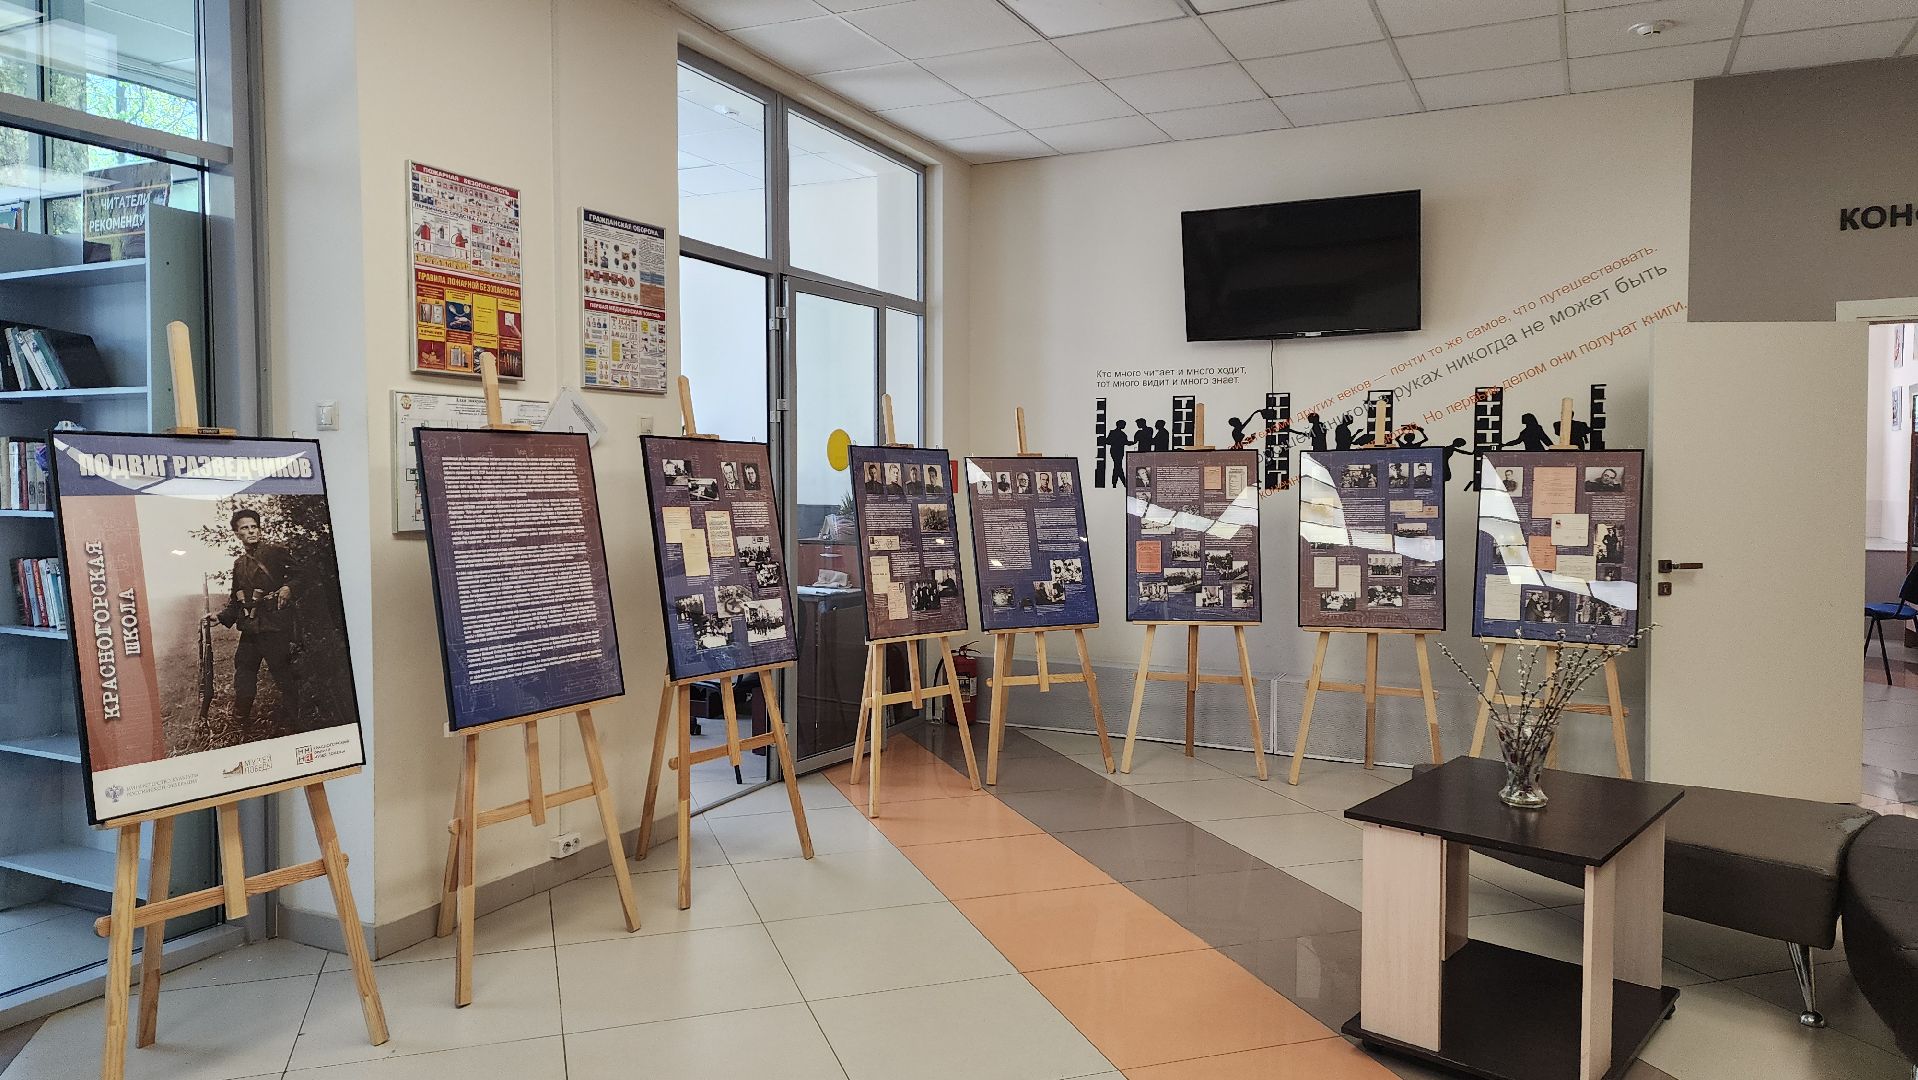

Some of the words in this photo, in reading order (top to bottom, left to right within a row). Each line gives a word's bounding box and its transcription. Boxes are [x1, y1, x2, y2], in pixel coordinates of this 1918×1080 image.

[101, 192, 152, 210] ЧИТАТЕЛИ
[89, 213, 146, 232] РЕКОМЕНДУ
[588, 213, 632, 230] ГРАЖДАНСКАЯ
[1840, 203, 1918, 231] КОН
[417, 271, 446, 284] ПРАВИЛА
[447, 277, 480, 290] ПОЖАРНОЙ
[1296, 397, 1335, 423] других
[1337, 380, 1372, 401] веков
[1390, 353, 1427, 377] почти
[1428, 346, 1443, 358] то
[1445, 336, 1463, 350] же
[1466, 313, 1512, 339] самое,
[1513, 301, 1537, 316] что
[1539, 246, 1658, 305] путешествовать.
[1393, 368, 1444, 402] руках
[1445, 333, 1518, 374] никогда
[1521, 320, 1545, 339] не
[1549, 288, 1611, 325] может
[1615, 265, 1668, 293] быть
[1096, 370, 1112, 378] Кто
[1114, 370, 1141, 379] много
[1143, 368, 1175, 377] читает
[1186, 367, 1215, 376] много
[1217, 366, 1247, 376] ходит,
[1423, 410, 1444, 425] Но
[1445, 384, 1499, 414] первым
[1502, 362, 1547, 392] делом
[1549, 349, 1577, 367] они
[1578, 321, 1638, 355] получат
[1641, 301, 1688, 327] книги.
[1096, 380, 1110, 388] тот
[1112, 379, 1140, 388] много
[1142, 378, 1170, 388] видит
[1180, 377, 1209, 386] много
[1211, 376, 1240, 385] знает.
[78, 453, 168, 480] ПОДВИГ
[172, 455, 313, 481] РАЗВЕДЧИКОВ
[85, 539, 121, 720] КРАСНОГОРСКАЯ
[118, 587, 141, 656] ШКОЛА
[244, 763, 273, 775] ПОБЕДЫ
